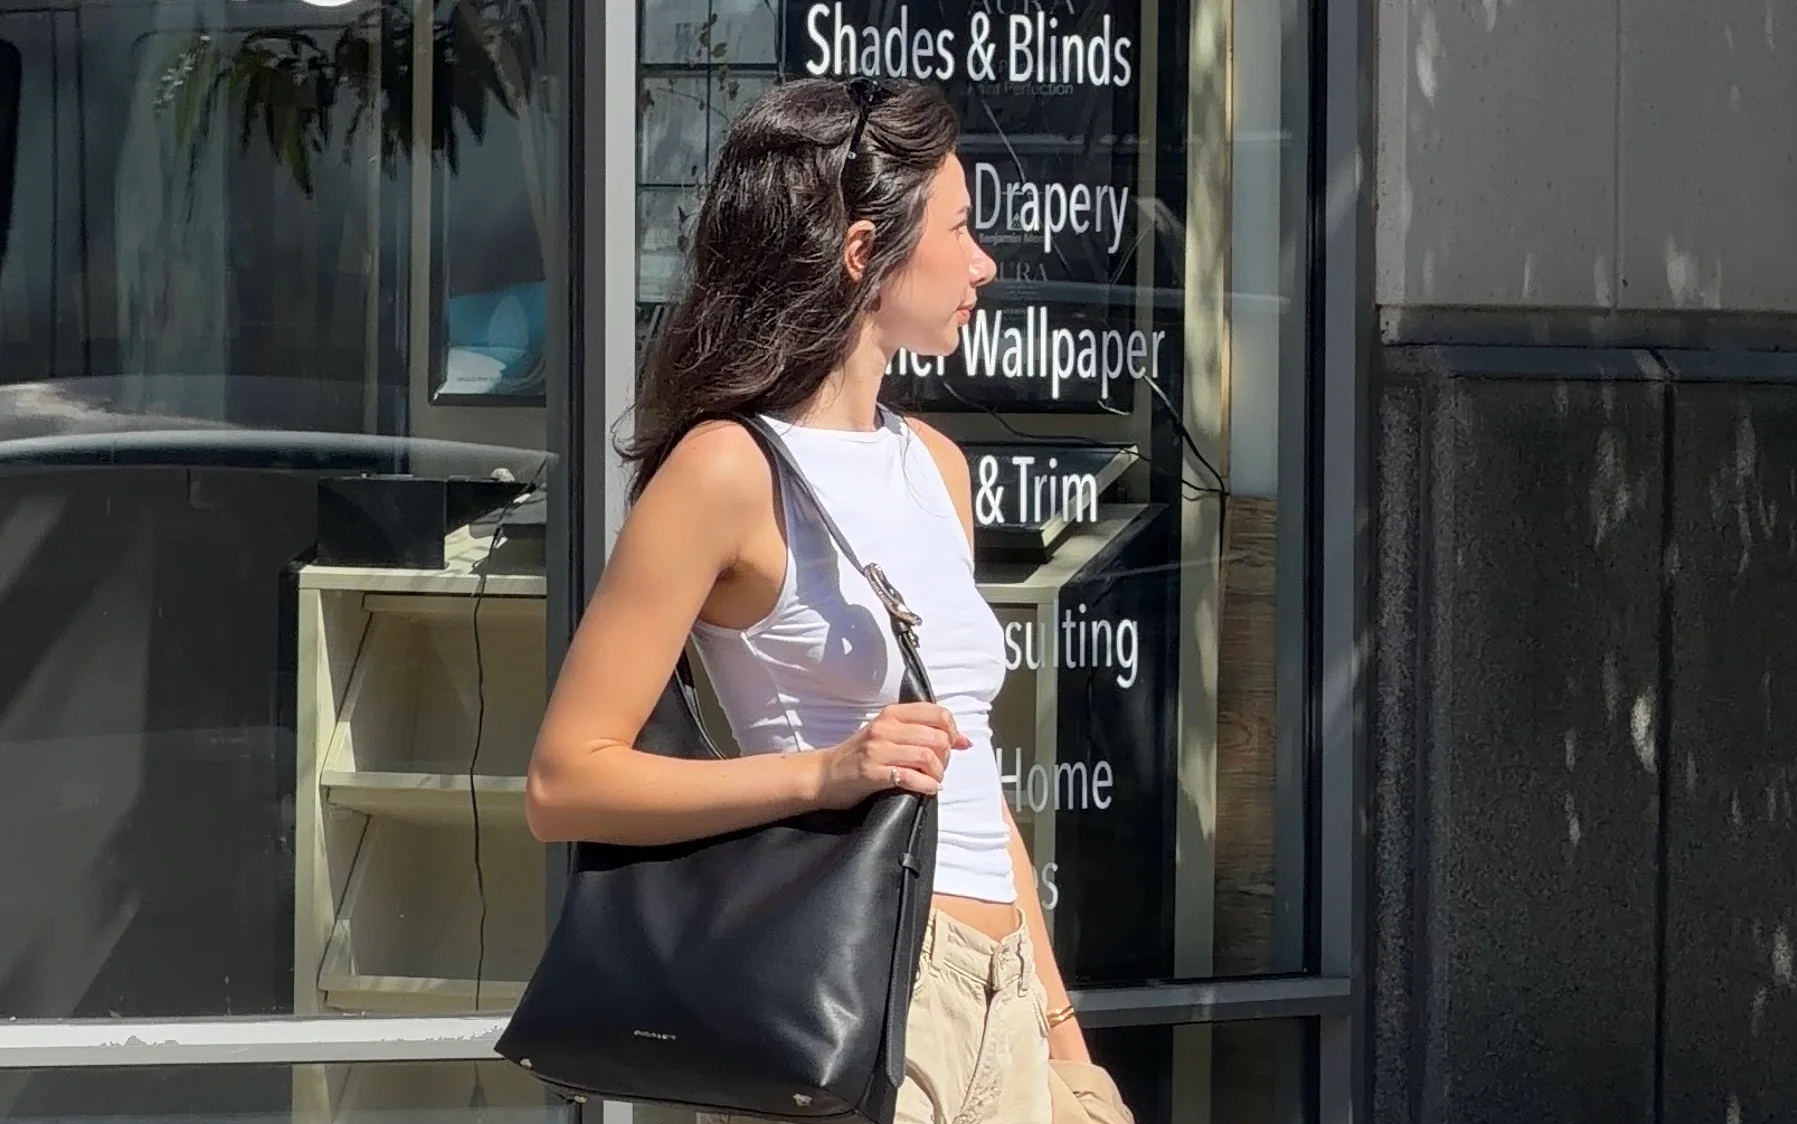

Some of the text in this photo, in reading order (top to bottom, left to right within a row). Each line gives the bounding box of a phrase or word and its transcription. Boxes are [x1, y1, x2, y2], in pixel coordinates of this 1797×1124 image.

[806, 1, 1132, 87] Shades & Blinds
[974, 162, 1130, 254] Drapery
[962, 305, 1166, 400] Wallpaper
[975, 455, 1098, 526] & Trim
[996, 746, 1114, 813] Home
